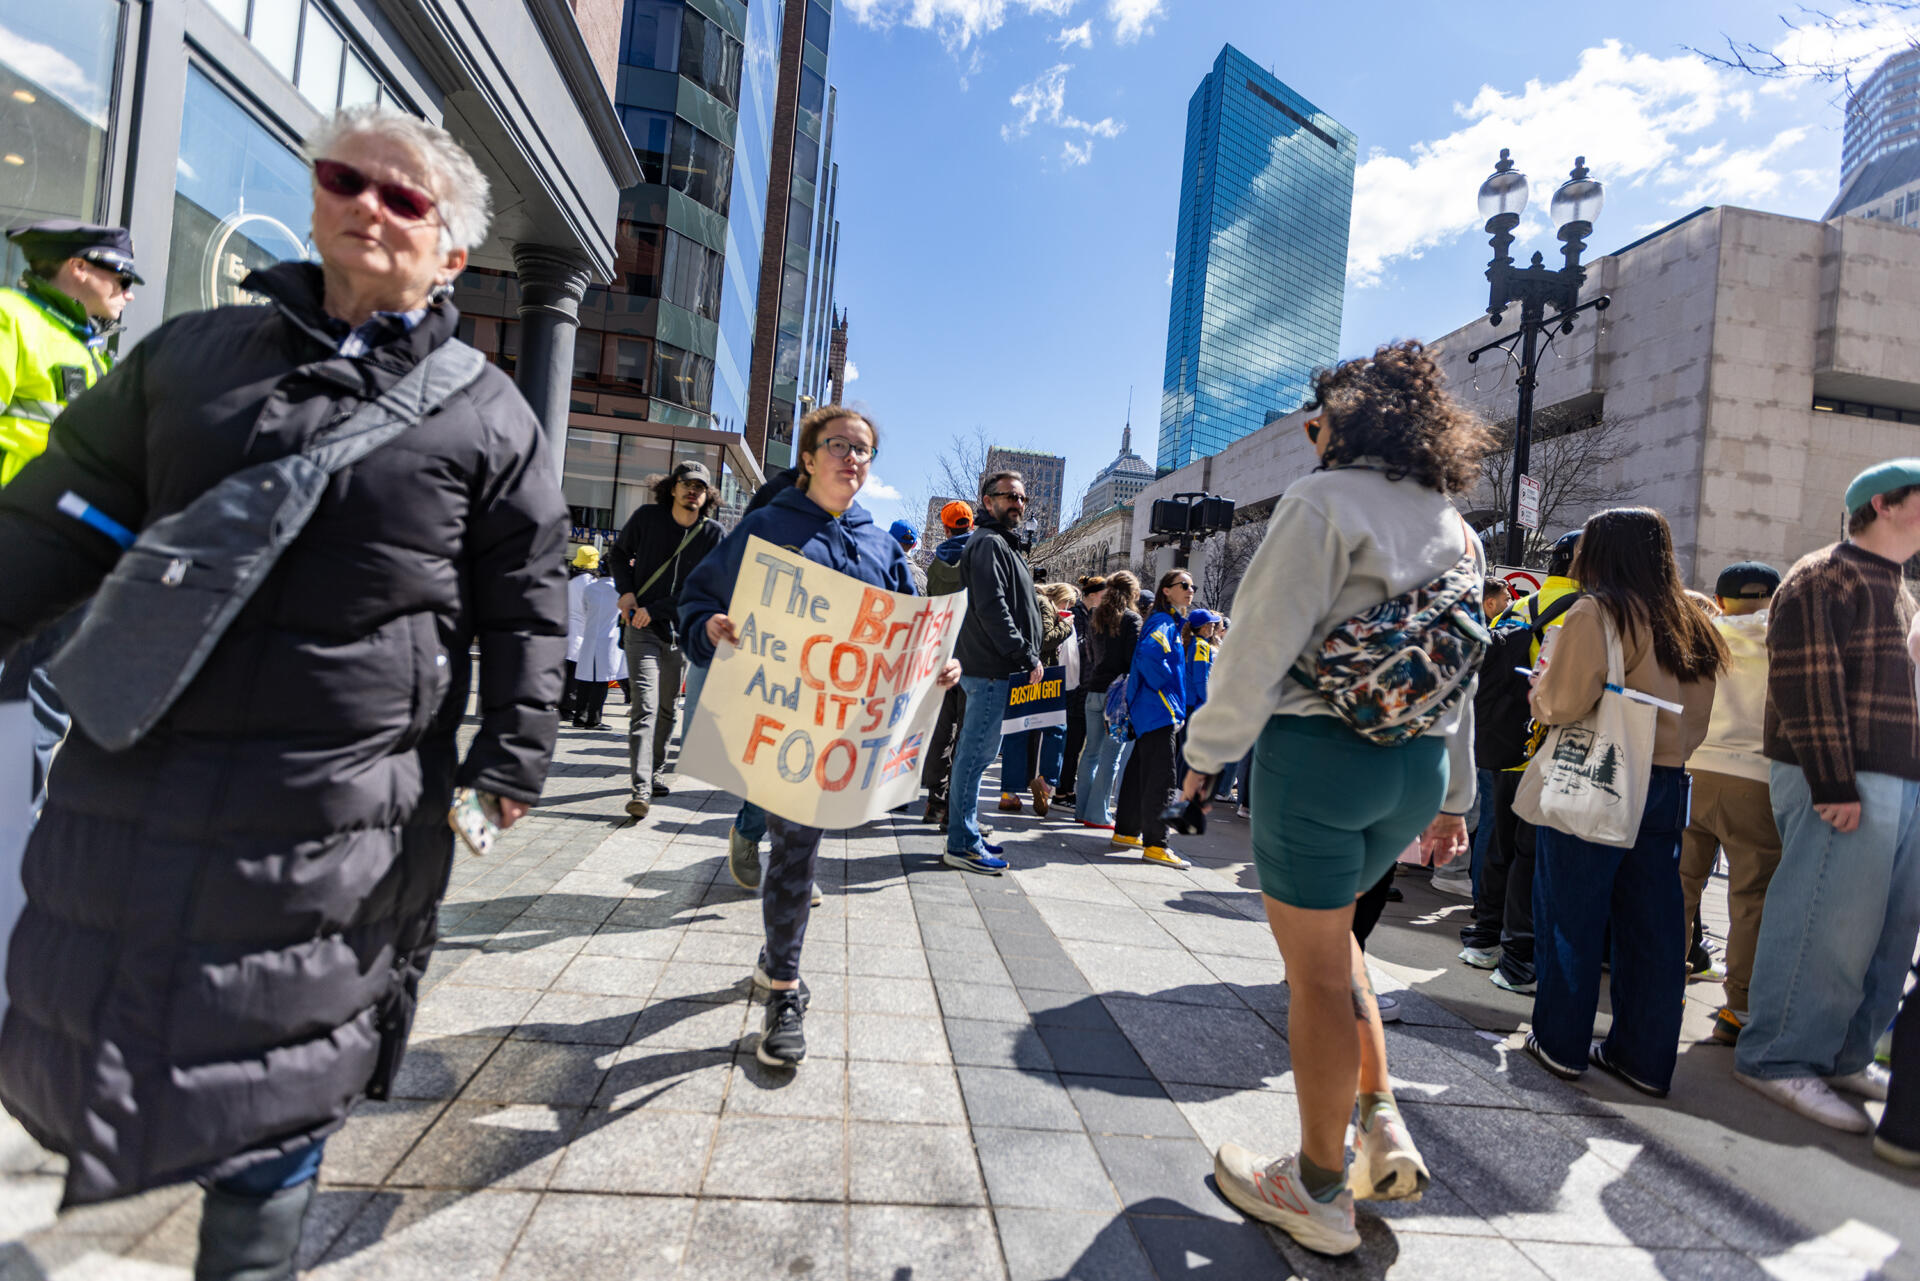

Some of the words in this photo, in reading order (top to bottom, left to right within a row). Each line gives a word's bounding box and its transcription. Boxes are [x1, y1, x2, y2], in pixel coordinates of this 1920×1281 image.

[756, 552, 830, 622] The
[848, 586, 954, 650] British
[735, 612, 786, 661] Are
[800, 634, 942, 697] COMING
[1009, 682, 1042, 706] BOSTON
[1042, 679, 1063, 699] GRIT
[744, 664, 801, 711] And
[814, 692, 886, 733] IT'S
[742, 714, 891, 792] FOOT
